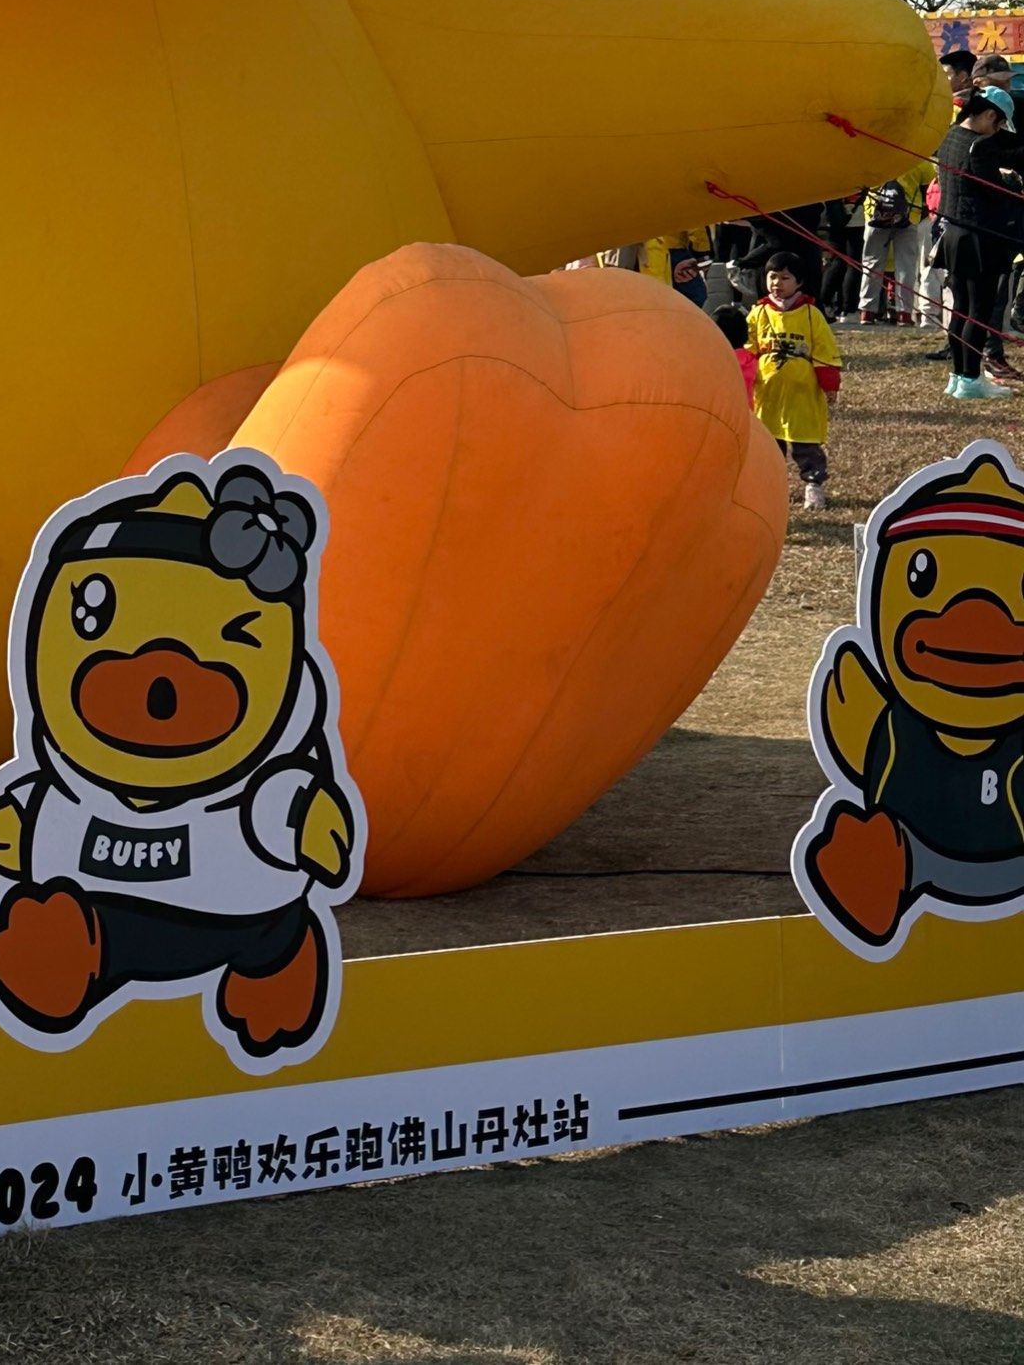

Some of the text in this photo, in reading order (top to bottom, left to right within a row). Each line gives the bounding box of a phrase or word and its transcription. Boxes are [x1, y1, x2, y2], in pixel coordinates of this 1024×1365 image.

[980, 768, 998, 805] B
[91, 834, 182, 869] BUFFY
[120, 1092, 590, 1207] 小黄鸭欢乐跑佛山丹灶站
